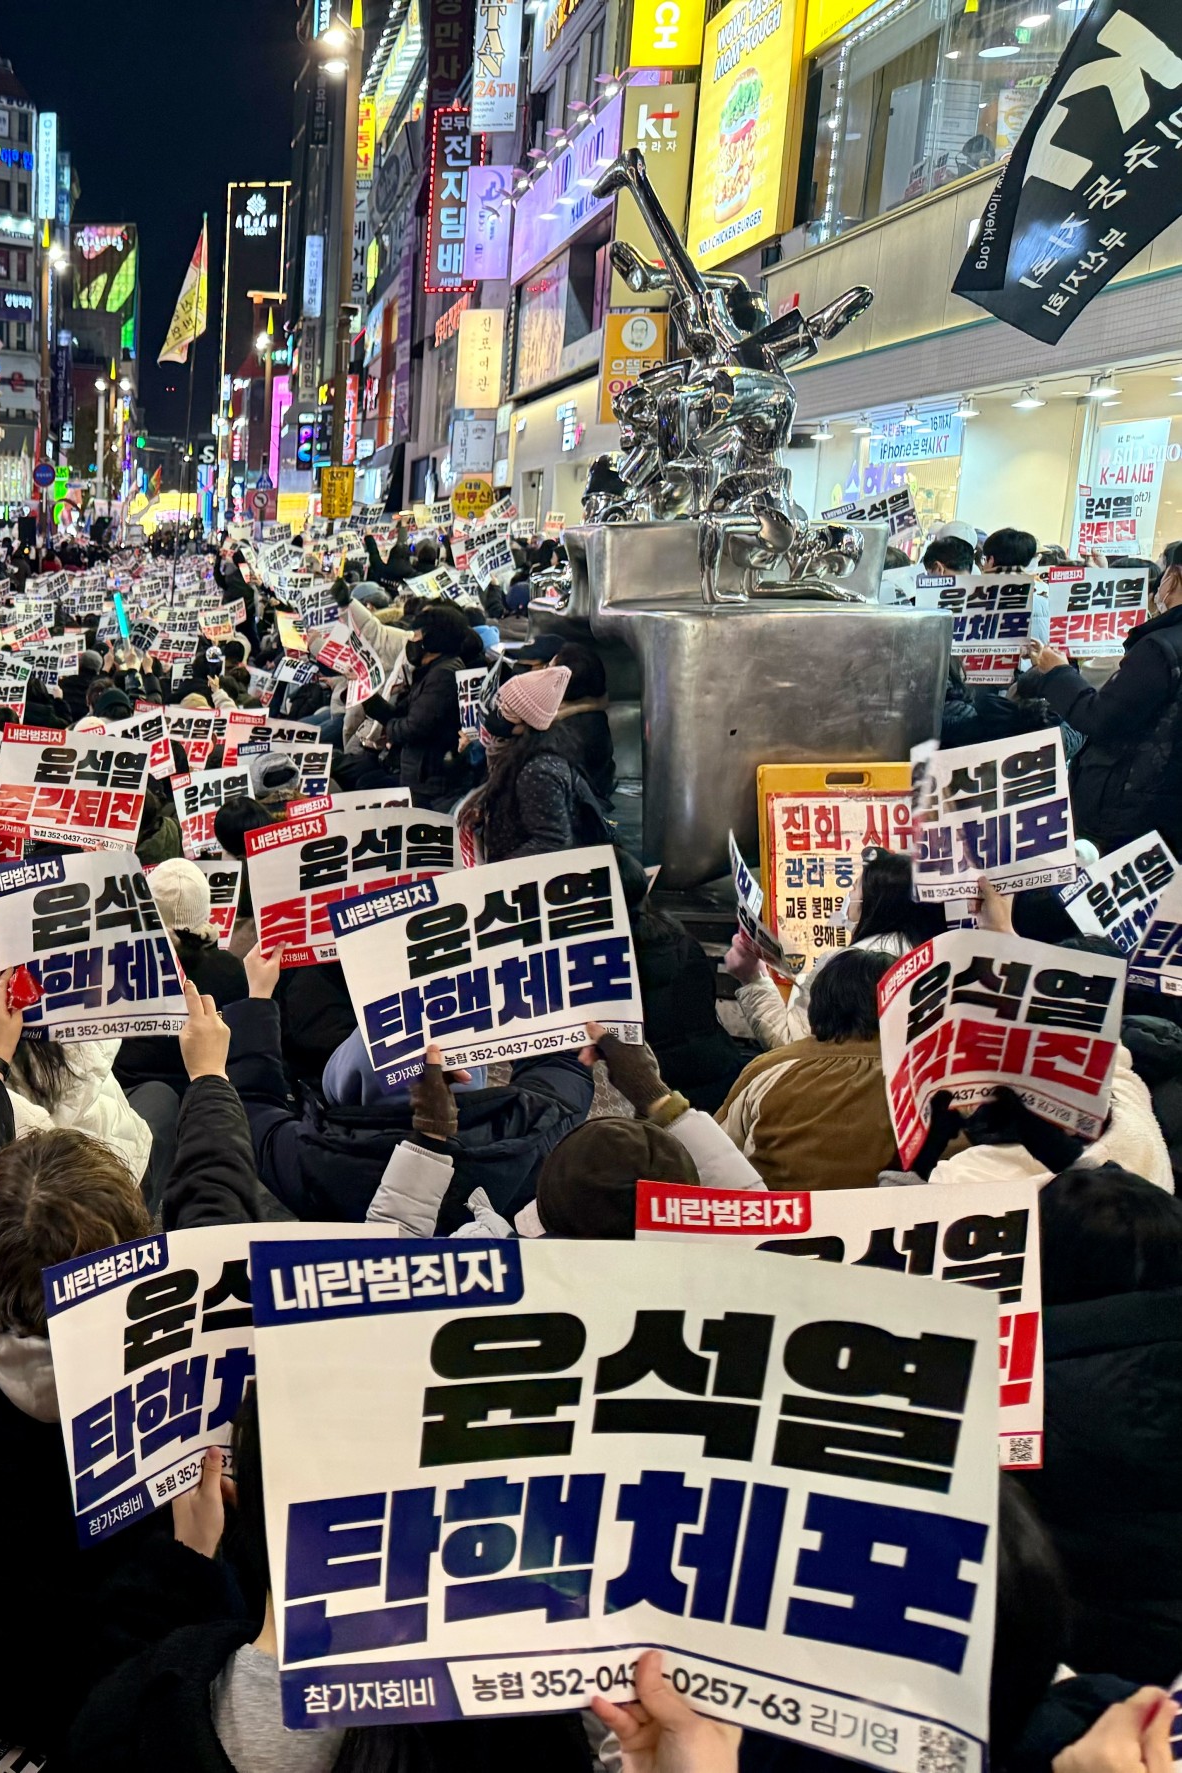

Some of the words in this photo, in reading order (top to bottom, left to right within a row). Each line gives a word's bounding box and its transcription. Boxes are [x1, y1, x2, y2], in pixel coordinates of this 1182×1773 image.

[476, 6, 507, 79] TAN
[745, 4, 783, 56] TOUCH
[473, 81, 516, 98] 24TH
[637, 102, 680, 140] kt
[711, 225, 738, 249] CHICKEN
[736, 209, 763, 236] BURGER
[454, 491, 492, 504] 부동산
[1084, 495, 1132, 520] 윤석열
[919, 575, 955, 588] 내란범죄자
[1049, 568, 1084, 581] 내란범죄자
[937, 582, 1032, 613] 윤석열
[1067, 578, 1146, 612] 윤석열
[160, 637, 197, 652] 윤석열
[7, 726, 63, 744] 내란범죄자
[33, 746, 149, 791] 윤석열
[290, 798, 330, 817] 내란범죄자
[251, 818, 323, 853] 내란범죄자
[299, 823, 454, 892] 윤석열
[784, 858, 825, 888] 관리
[834, 857, 854, 888] 중
[336, 883, 433, 929] 내란범죄자
[404, 866, 614, 980] 윤석열
[785, 897, 807, 919] 교통
[362, 935, 633, 1070] 탄핵체포
[904, 955, 1117, 1046] 윤석열
[54, 1026, 75, 1039] 농협
[76, 1018, 171, 1037] 352-0437-0257-63
[444, 1051, 468, 1067] 농협
[469, 1030, 587, 1063] 352-0437-0257-63
[648, 1193, 804, 1230] 내란범죄자
[51, 1241, 163, 1307] 내란범죄자
[270, 1247, 509, 1313] 내란범죄자
[418, 1308, 977, 1496] 윤석열
[87, 1494, 145, 1539] 참가자회비
[154, 1472, 178, 1499] 농협
[283, 1469, 989, 1674] 탄핵체포
[303, 1677, 437, 1715] 참가자회비
[470, 1667, 524, 1704] 농협
[530, 1662, 802, 1729] 352-043-0257-63
[809, 1703, 901, 1758] 김기영
